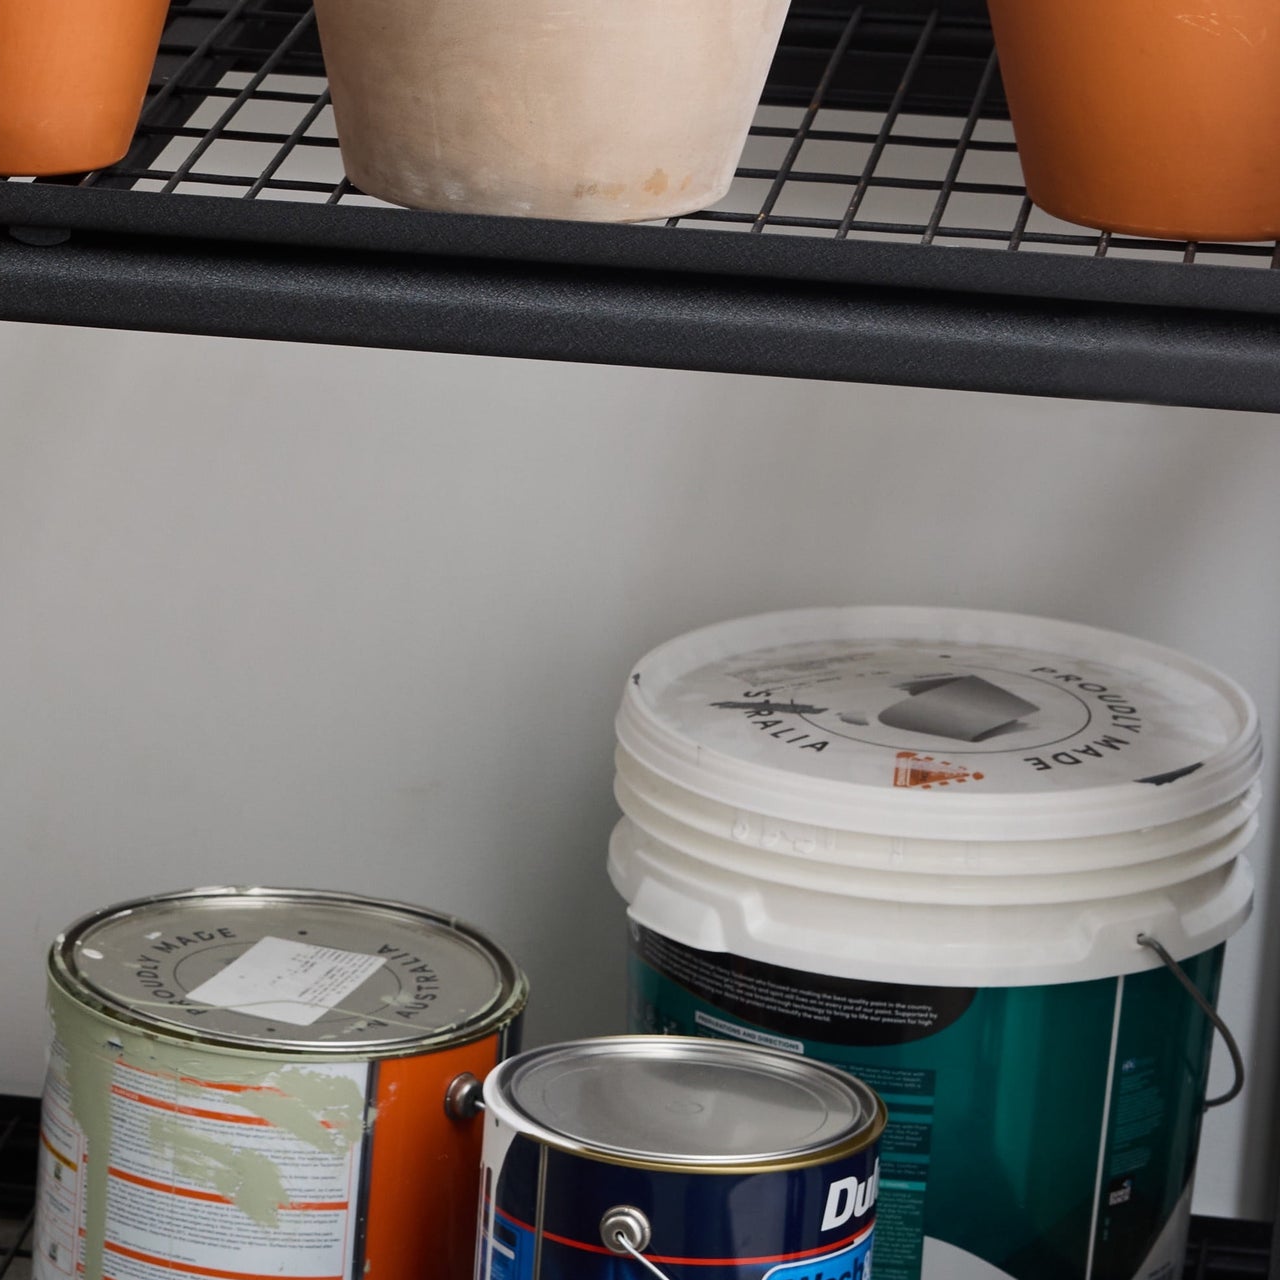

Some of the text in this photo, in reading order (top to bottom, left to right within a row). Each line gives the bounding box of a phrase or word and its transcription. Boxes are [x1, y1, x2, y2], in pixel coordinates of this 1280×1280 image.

[1022, 665, 1143, 771] PROUDLY MADE
[139, 954, 208, 1017] PROUDLY
[377, 943, 439, 1020] AUSTRALIA
[757, 1035, 800, 1051] DIRECTIONS
[895, 1009, 928, 1019] Supported
